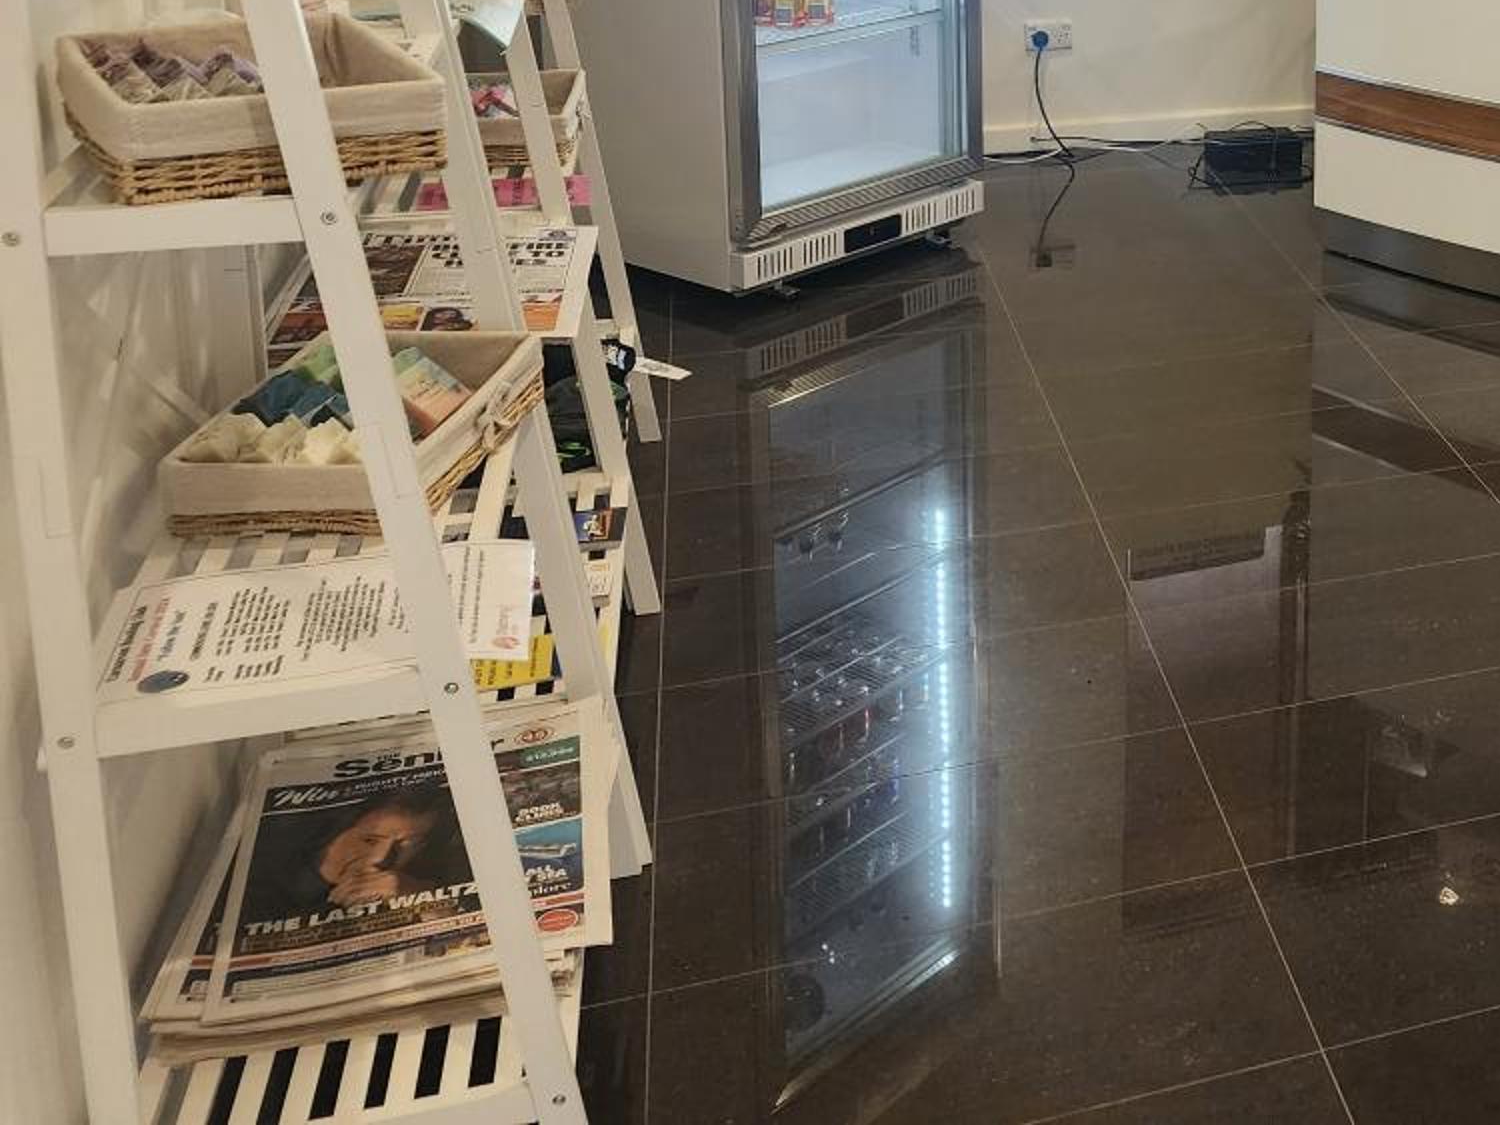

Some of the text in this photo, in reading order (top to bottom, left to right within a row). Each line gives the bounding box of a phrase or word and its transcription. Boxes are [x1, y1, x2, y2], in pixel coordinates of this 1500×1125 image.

[244, 882, 480, 936] THE LAST WALTZ
